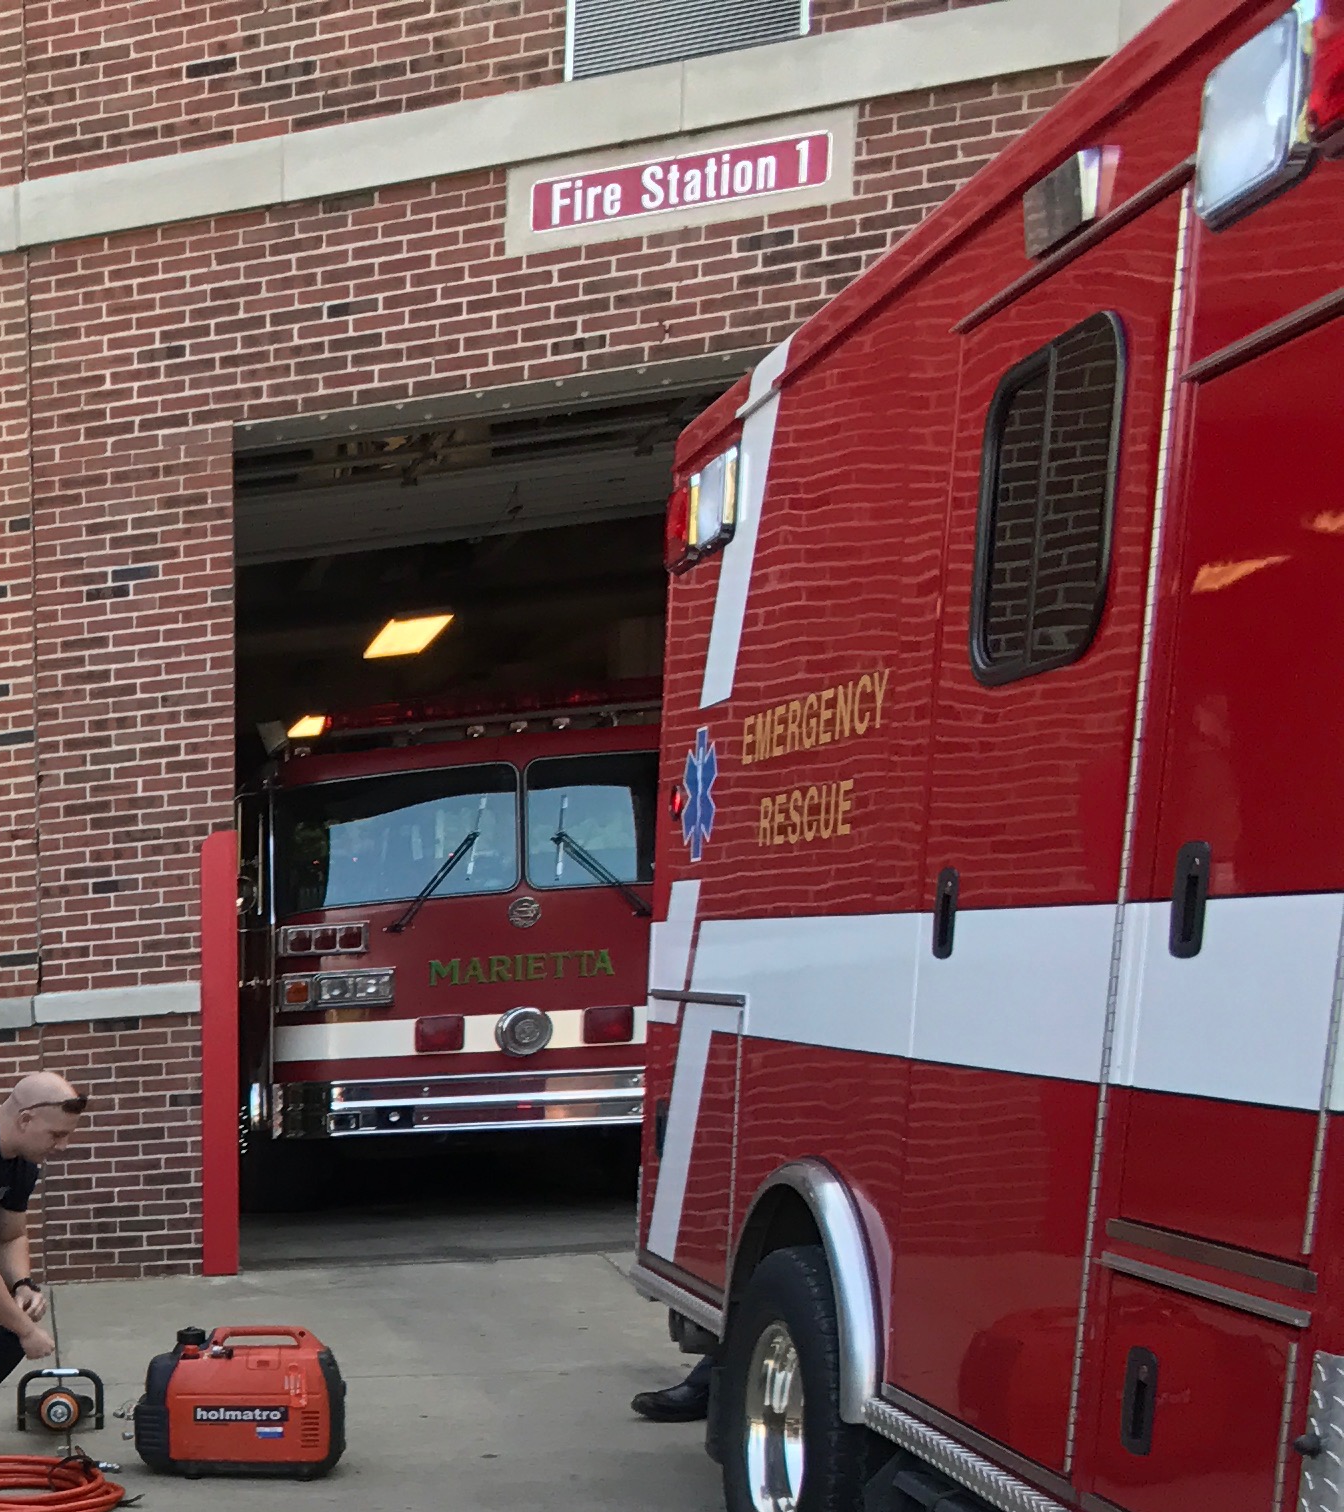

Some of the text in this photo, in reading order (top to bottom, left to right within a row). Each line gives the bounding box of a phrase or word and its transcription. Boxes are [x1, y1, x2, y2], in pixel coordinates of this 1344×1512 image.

[551, 139, 810, 226] Fire Station 1
[741, 668, 890, 765] EMERGENCY
[758, 779, 854, 847] RESCUE
[428, 948, 616, 987] MARIETTA
[196, 1407, 282, 1420] holmatro
